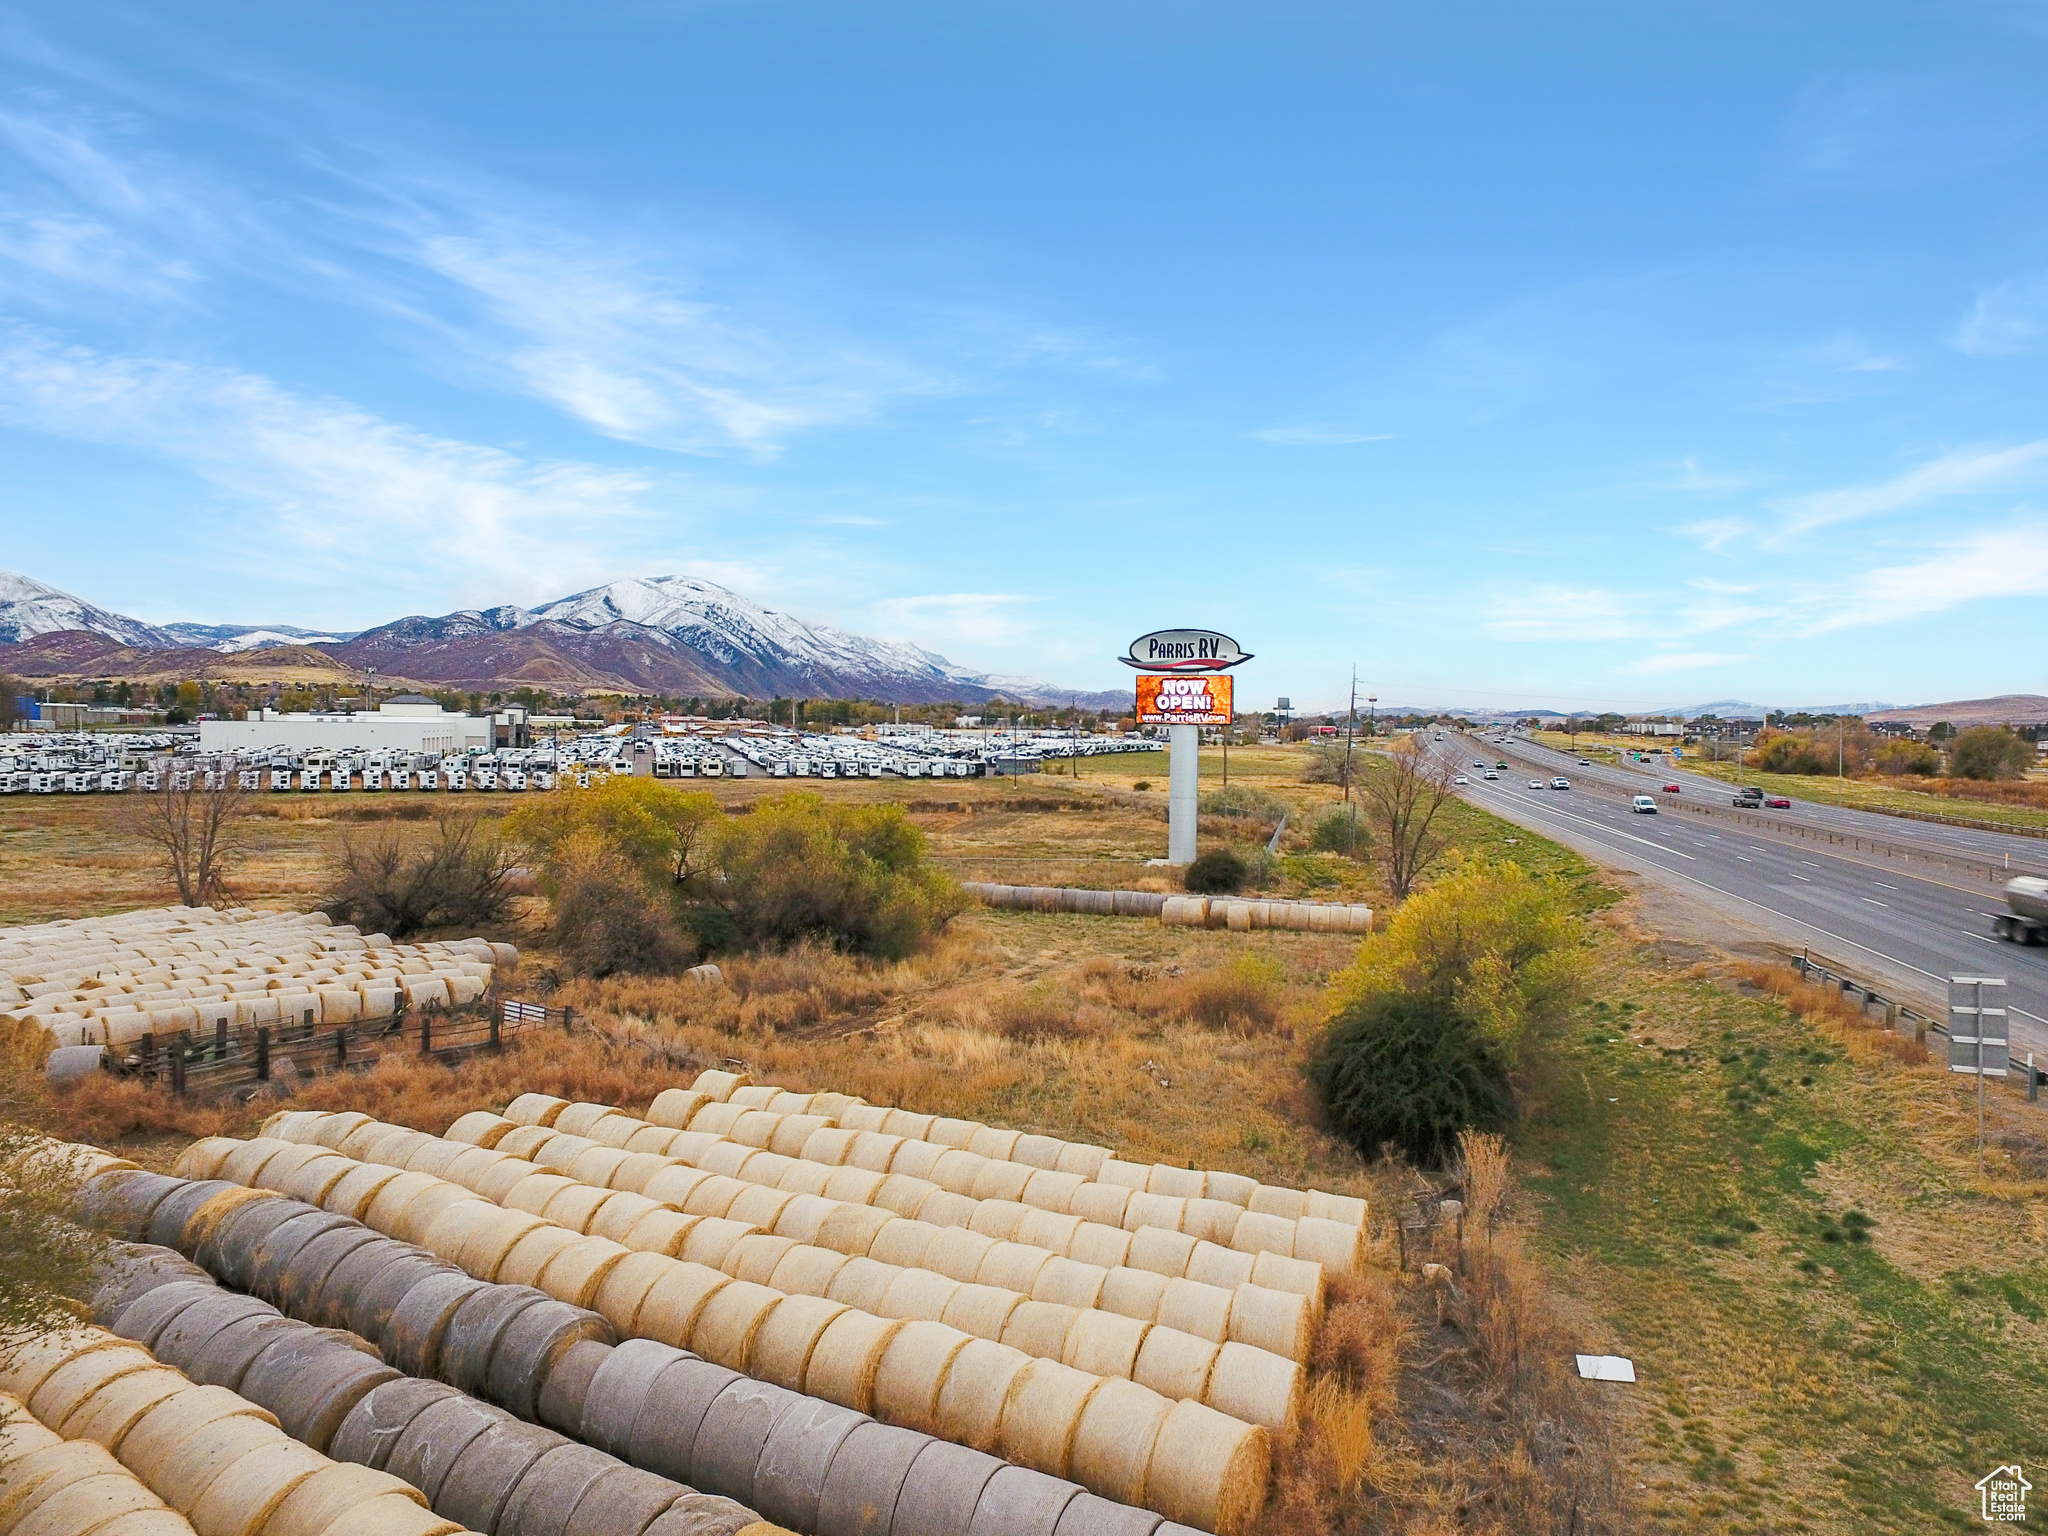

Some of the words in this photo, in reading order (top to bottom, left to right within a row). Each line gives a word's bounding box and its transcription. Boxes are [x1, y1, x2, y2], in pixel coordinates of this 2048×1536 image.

[1149, 638, 1195, 659] PARRIS
[1199, 638, 1219, 659] RV
[1162, 680, 1206, 695] NOW
[1156, 696, 1211, 709] OPEN!
[1141, 713, 1226, 722] www.ParrisRV.com
